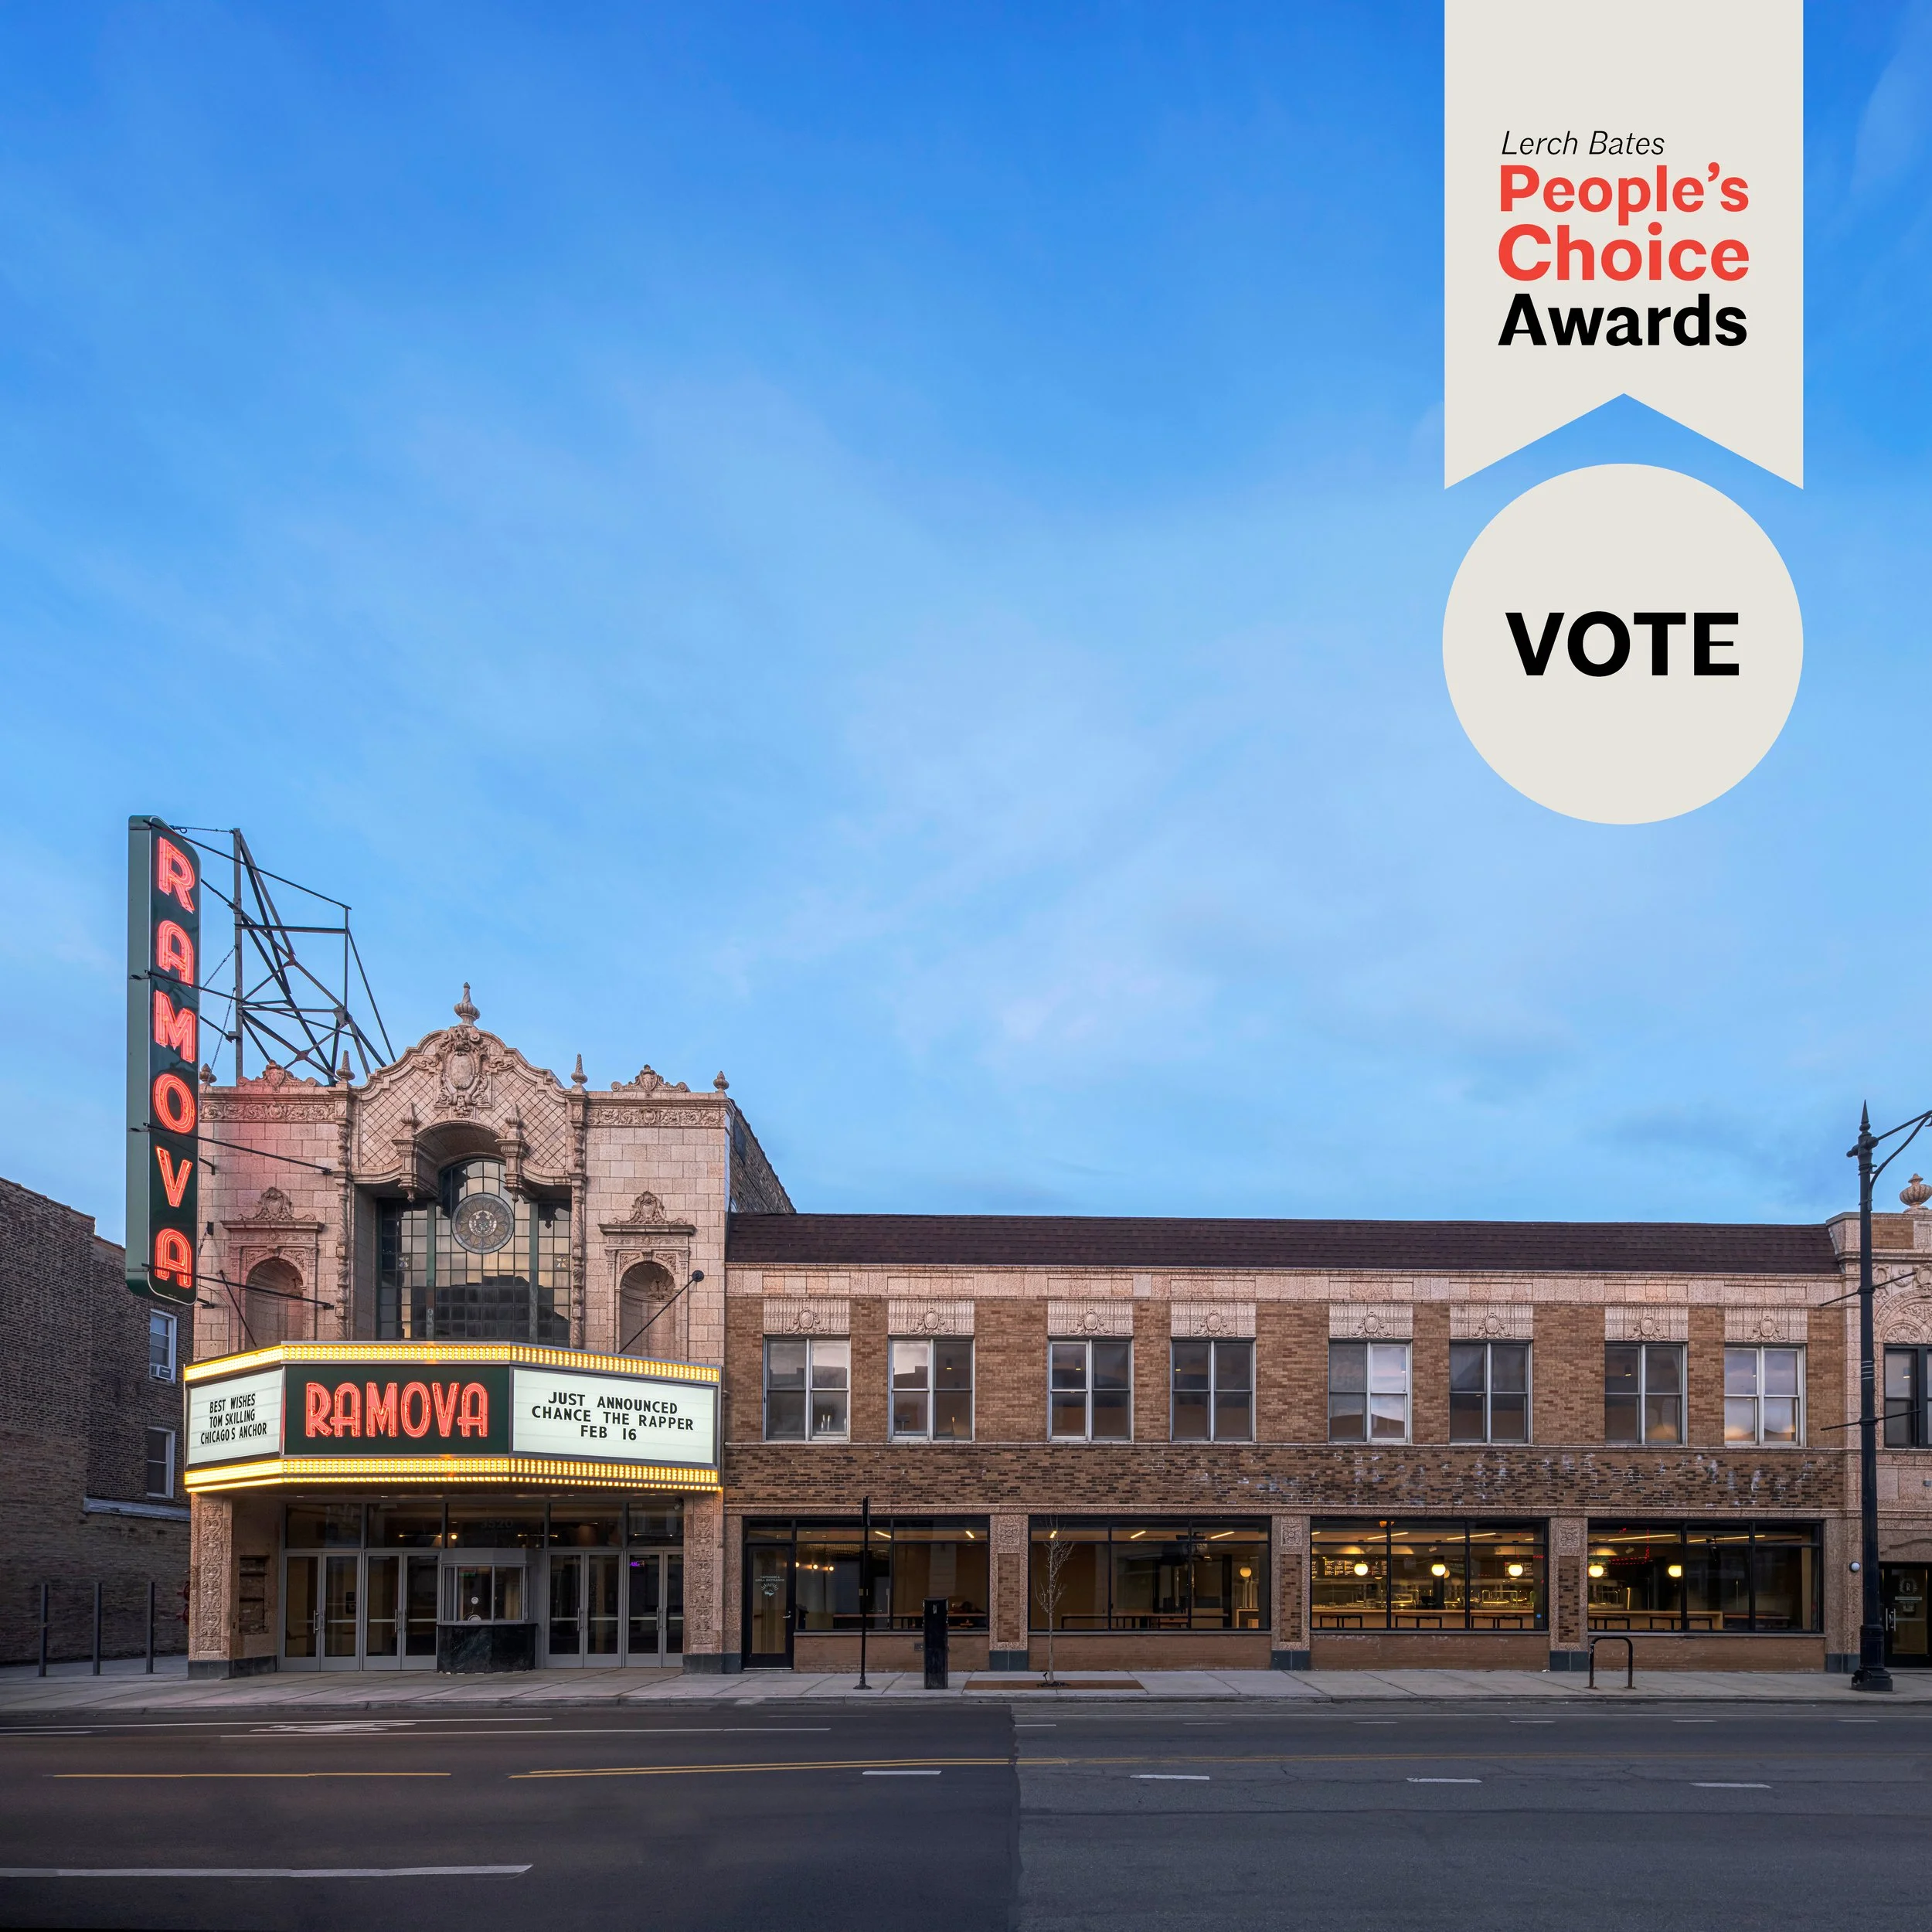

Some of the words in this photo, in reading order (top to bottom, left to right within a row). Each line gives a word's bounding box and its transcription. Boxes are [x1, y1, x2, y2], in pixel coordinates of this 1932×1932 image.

[153, 836, 196, 1289] RAMOVA
[209, 1400, 226, 1413] BEST
[231, 1393, 256, 1410] WISHES
[306, 1382, 488, 1437] RAMOVA
[548, 1391, 586, 1406] JUST
[597, 1396, 678, 1414] ANNOUNCED
[209, 1414, 223, 1428] TOM
[225, 1409, 255, 1426] SKILLING
[531, 1405, 591, 1422] CHANCE
[603, 1411, 630, 1426] THE
[638, 1414, 694, 1430] RAPPER
[239, 1423, 267, 1439] ANCHOR
[580, 1425, 607, 1439] FEB
[622, 1427, 638, 1441] 16
[480, 1518, 513, 1529] 3520
